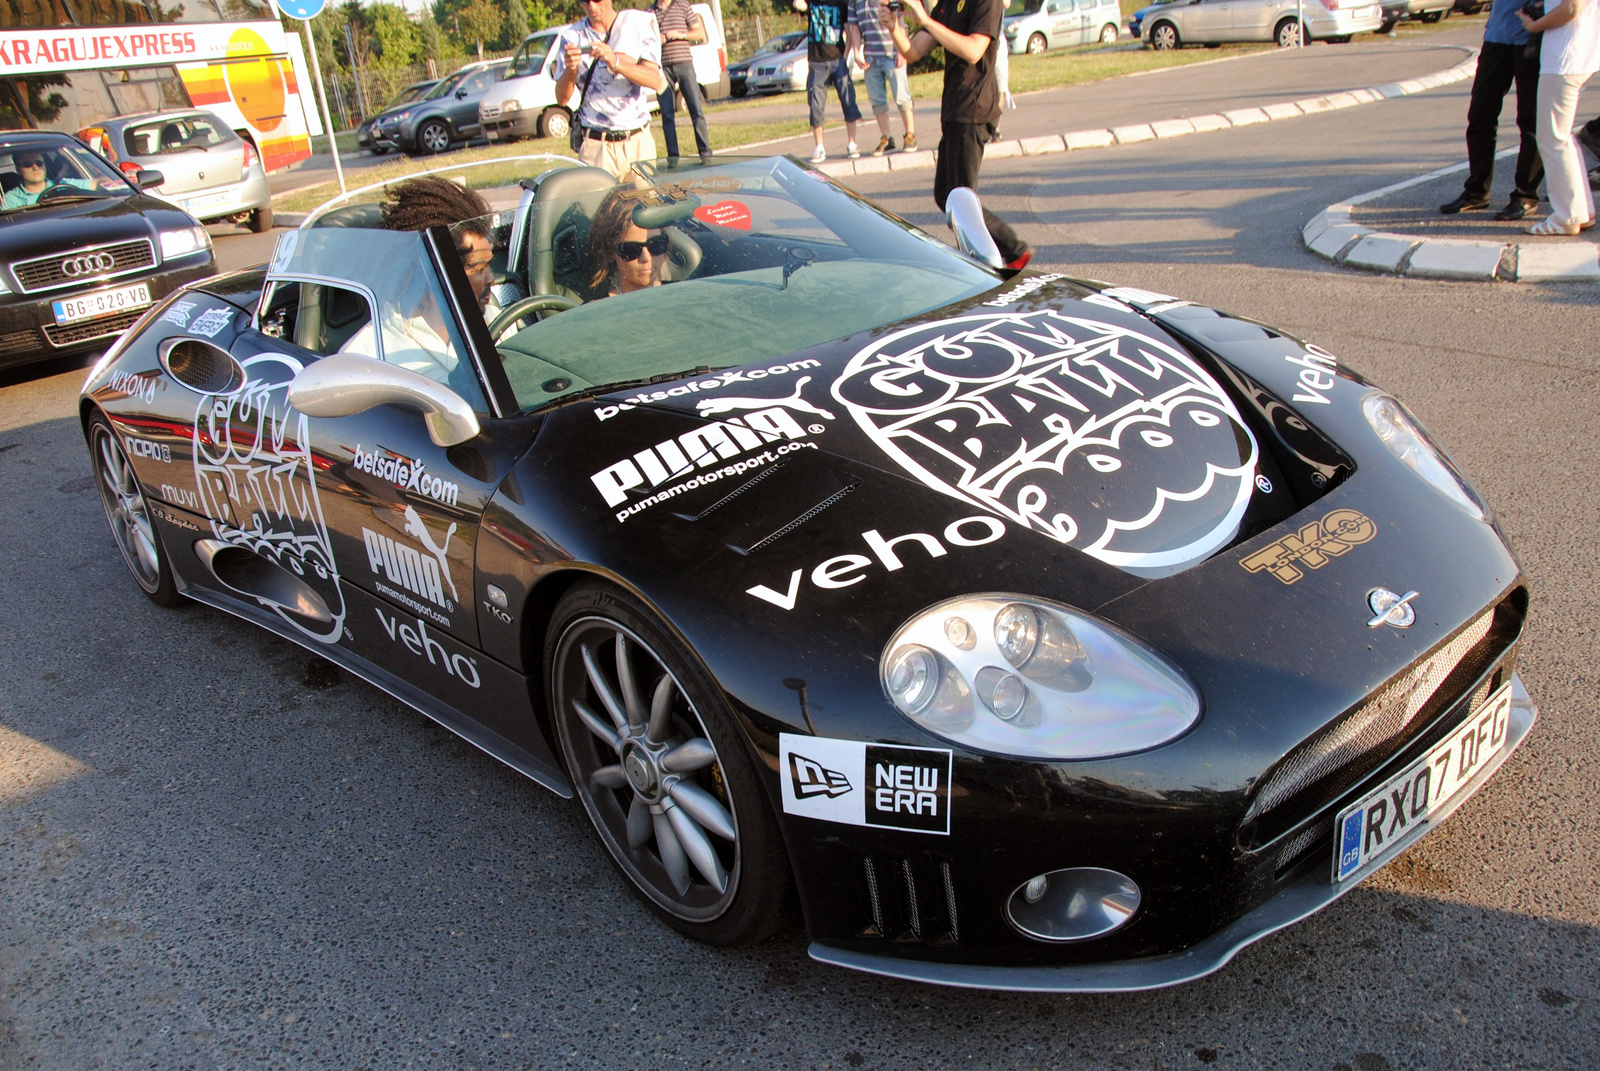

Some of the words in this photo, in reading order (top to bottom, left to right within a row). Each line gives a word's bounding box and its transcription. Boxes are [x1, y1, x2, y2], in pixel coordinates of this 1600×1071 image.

[65, 300, 87, 318] BG
[107, 369, 148, 400] NIXON
[1284, 343, 1337, 405] veho
[590, 407, 808, 509] PUMA
[615, 442, 819, 523] pumamotorsport.com
[361, 526, 447, 610] PUMA
[745, 515, 1007, 611] veho
[1238, 508, 1378, 586] TKO
[375, 580, 451, 628] pumamotorsport.com
[483, 600, 512, 625] TKO
[374, 607, 481, 689] veho
[1456, 697, 1508, 783] DFG
[875, 762, 938, 793] NEW
[875, 787, 938, 817] ERA
[1342, 846, 1360, 868] GB
